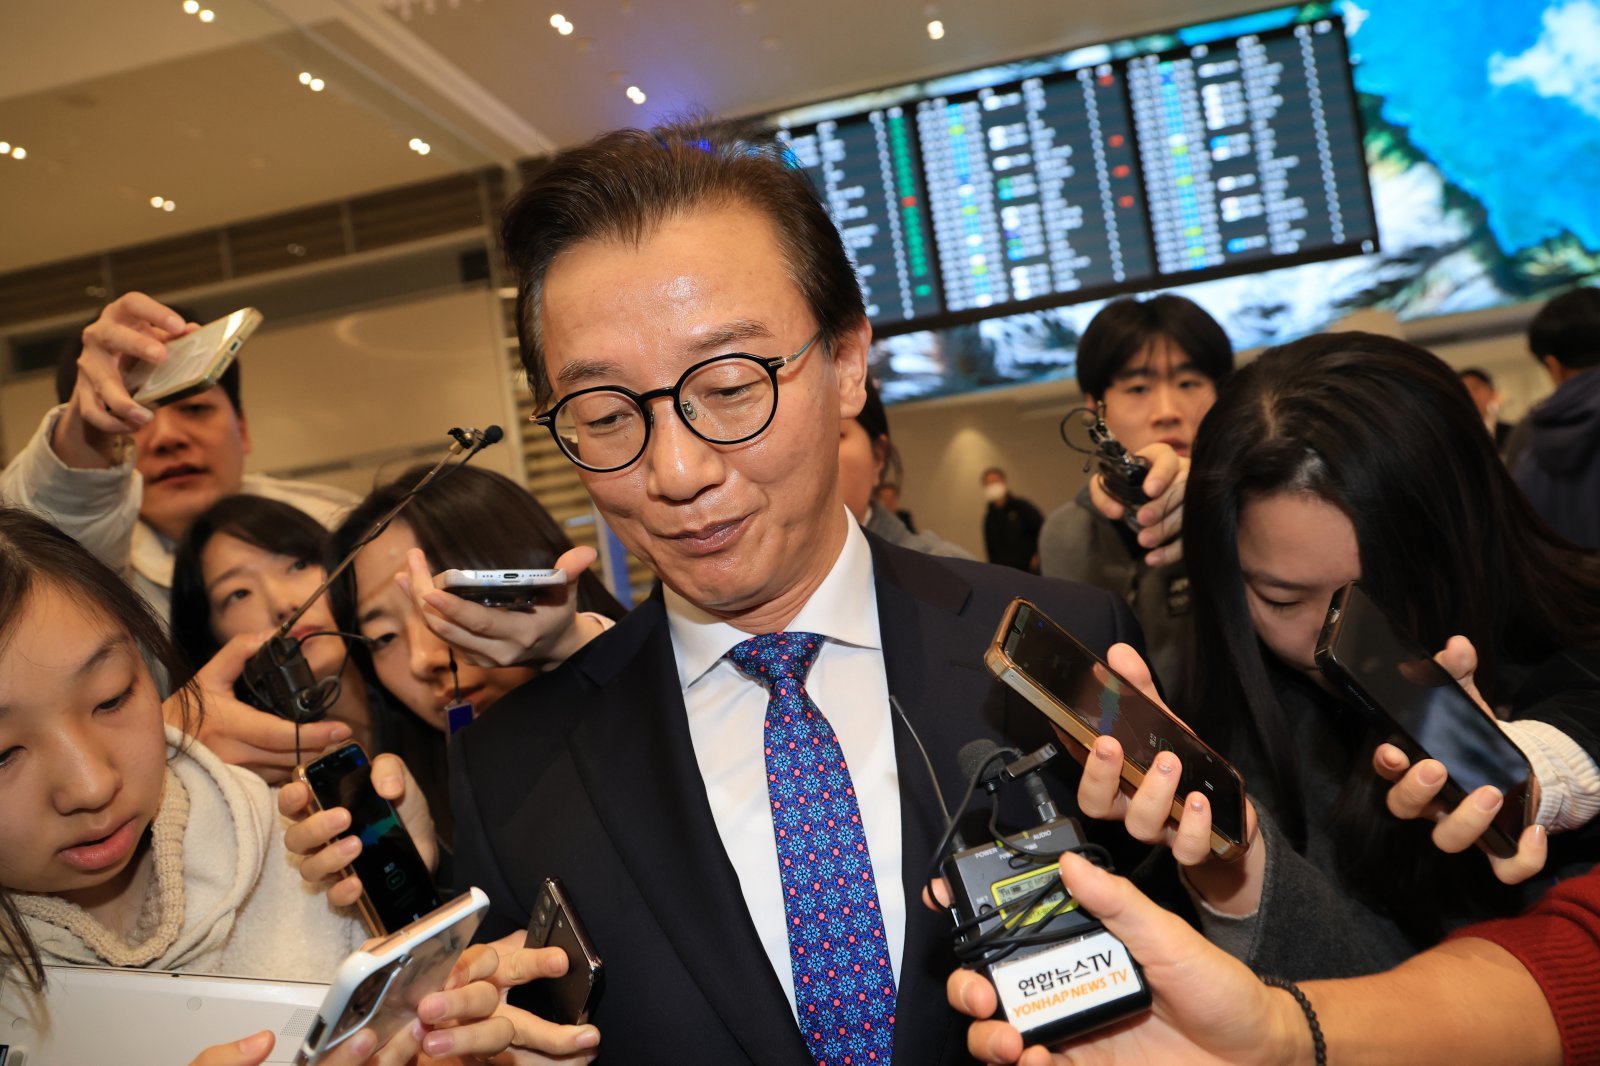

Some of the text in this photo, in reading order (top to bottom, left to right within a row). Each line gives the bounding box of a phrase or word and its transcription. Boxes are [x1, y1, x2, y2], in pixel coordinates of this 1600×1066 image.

[1033, 830, 1052, 840] AUDIO
[975, 847, 998, 859] POWER
[1018, 950, 1112, 997] 연합뉴스TV
[1109, 968, 1127, 985] TV
